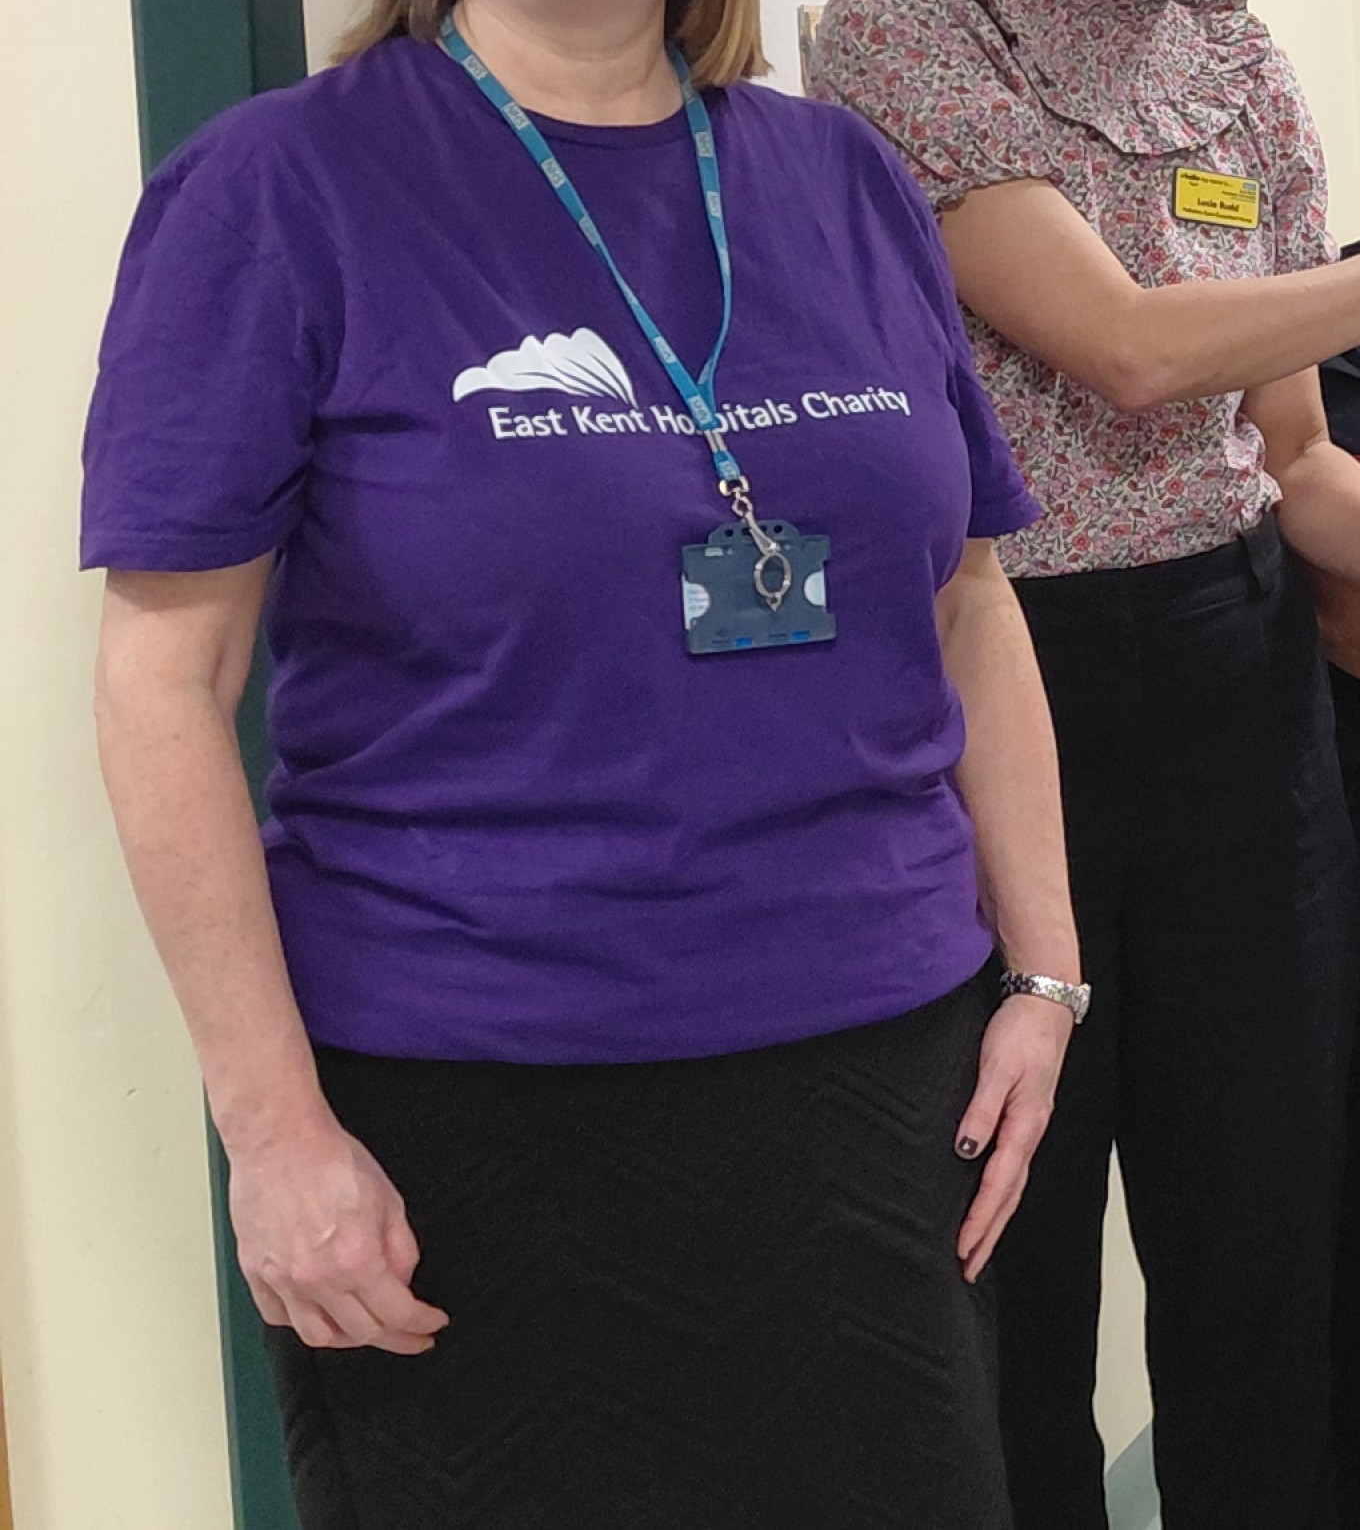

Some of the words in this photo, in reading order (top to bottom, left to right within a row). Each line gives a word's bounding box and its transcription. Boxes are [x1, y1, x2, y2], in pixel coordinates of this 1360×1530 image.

[488, 405, 566, 439] East
[572, 404, 651, 434] Kent
[649, 398, 797, 436] Hopitals
[802, 386, 912, 419] Charity
